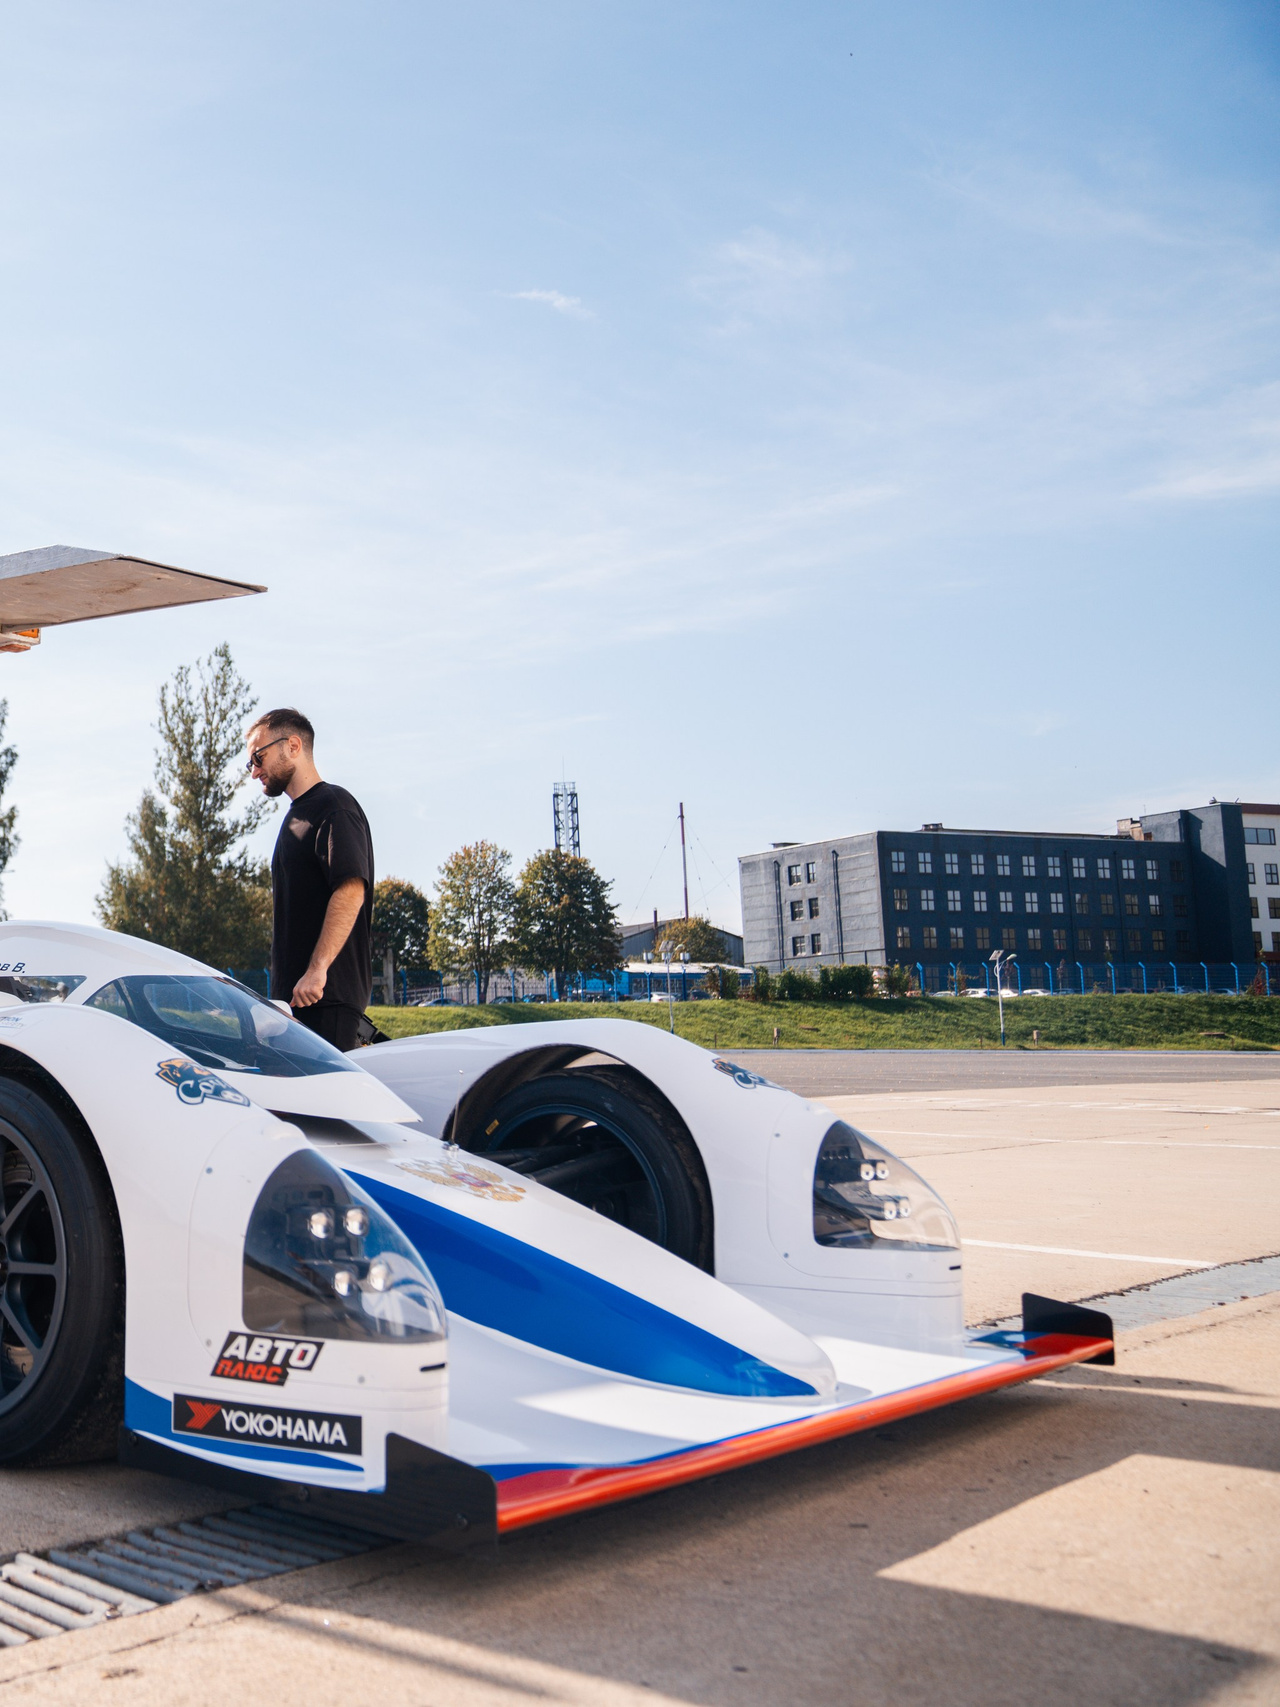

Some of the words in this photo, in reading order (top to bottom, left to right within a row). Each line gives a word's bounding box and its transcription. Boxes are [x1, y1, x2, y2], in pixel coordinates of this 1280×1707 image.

[12, 962, 26, 974] В.
[222, 1335, 318, 1368] АВТО
[215, 1358, 283, 1383] ПЛЮС
[221, 1408, 348, 1446] YOKOHAMA
